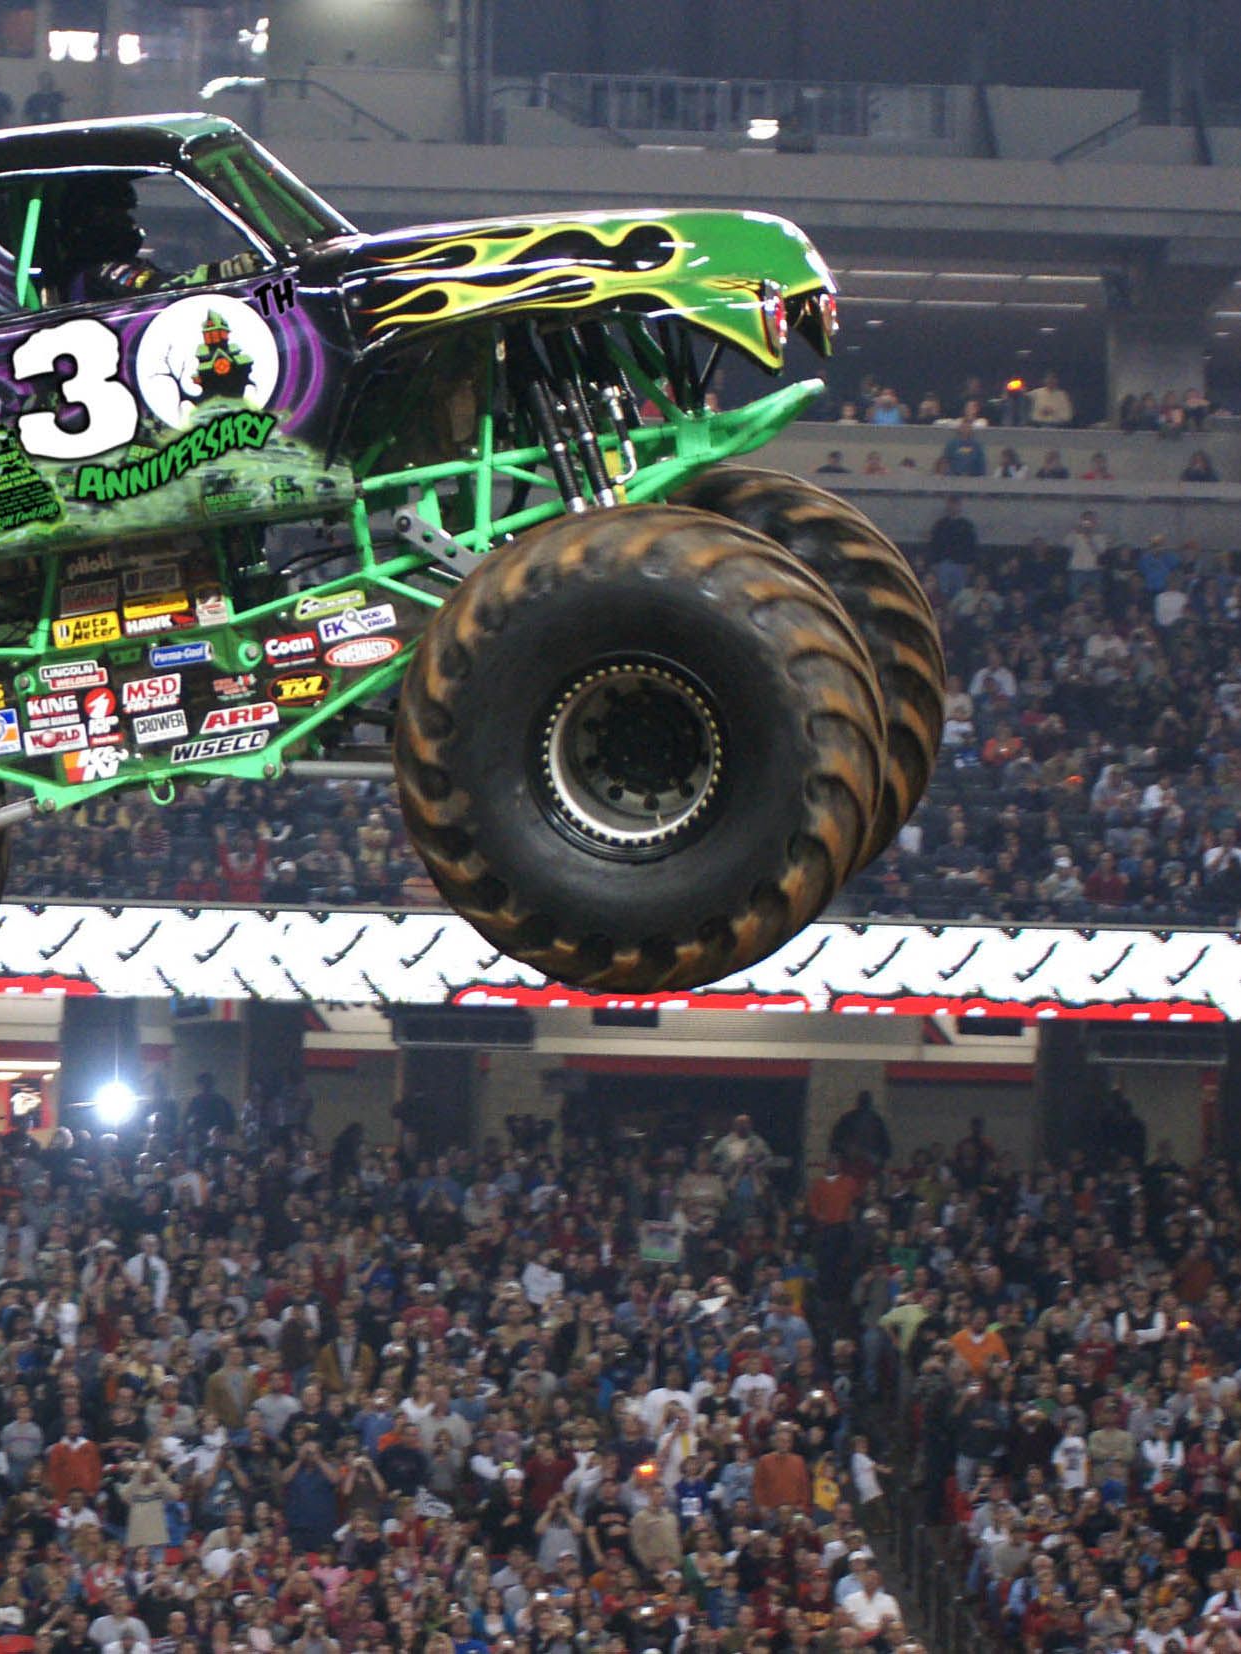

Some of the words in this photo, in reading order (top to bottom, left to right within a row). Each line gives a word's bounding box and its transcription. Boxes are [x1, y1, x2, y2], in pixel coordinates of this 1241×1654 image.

[13, 293, 280, 460] 30
[253, 277, 296, 319] TH
[78, 413, 277, 500] ANNIVERSARY
[72, 626, 116, 644] Meter
[74, 617, 108, 631] Auto
[124, 613, 174, 635] HAWK
[323, 620, 348, 638] FK
[265, 637, 315, 657] Coan
[43, 663, 94, 678] LINCOLN
[55, 674, 101, 688] WELDERS
[127, 677, 177, 700] MSD
[27, 695, 79, 717] KING
[205, 704, 275, 729] ARP
[136, 712, 185, 735] CROWER
[30, 729, 80, 748] WORLD
[173, 731, 266, 762] WISECO
